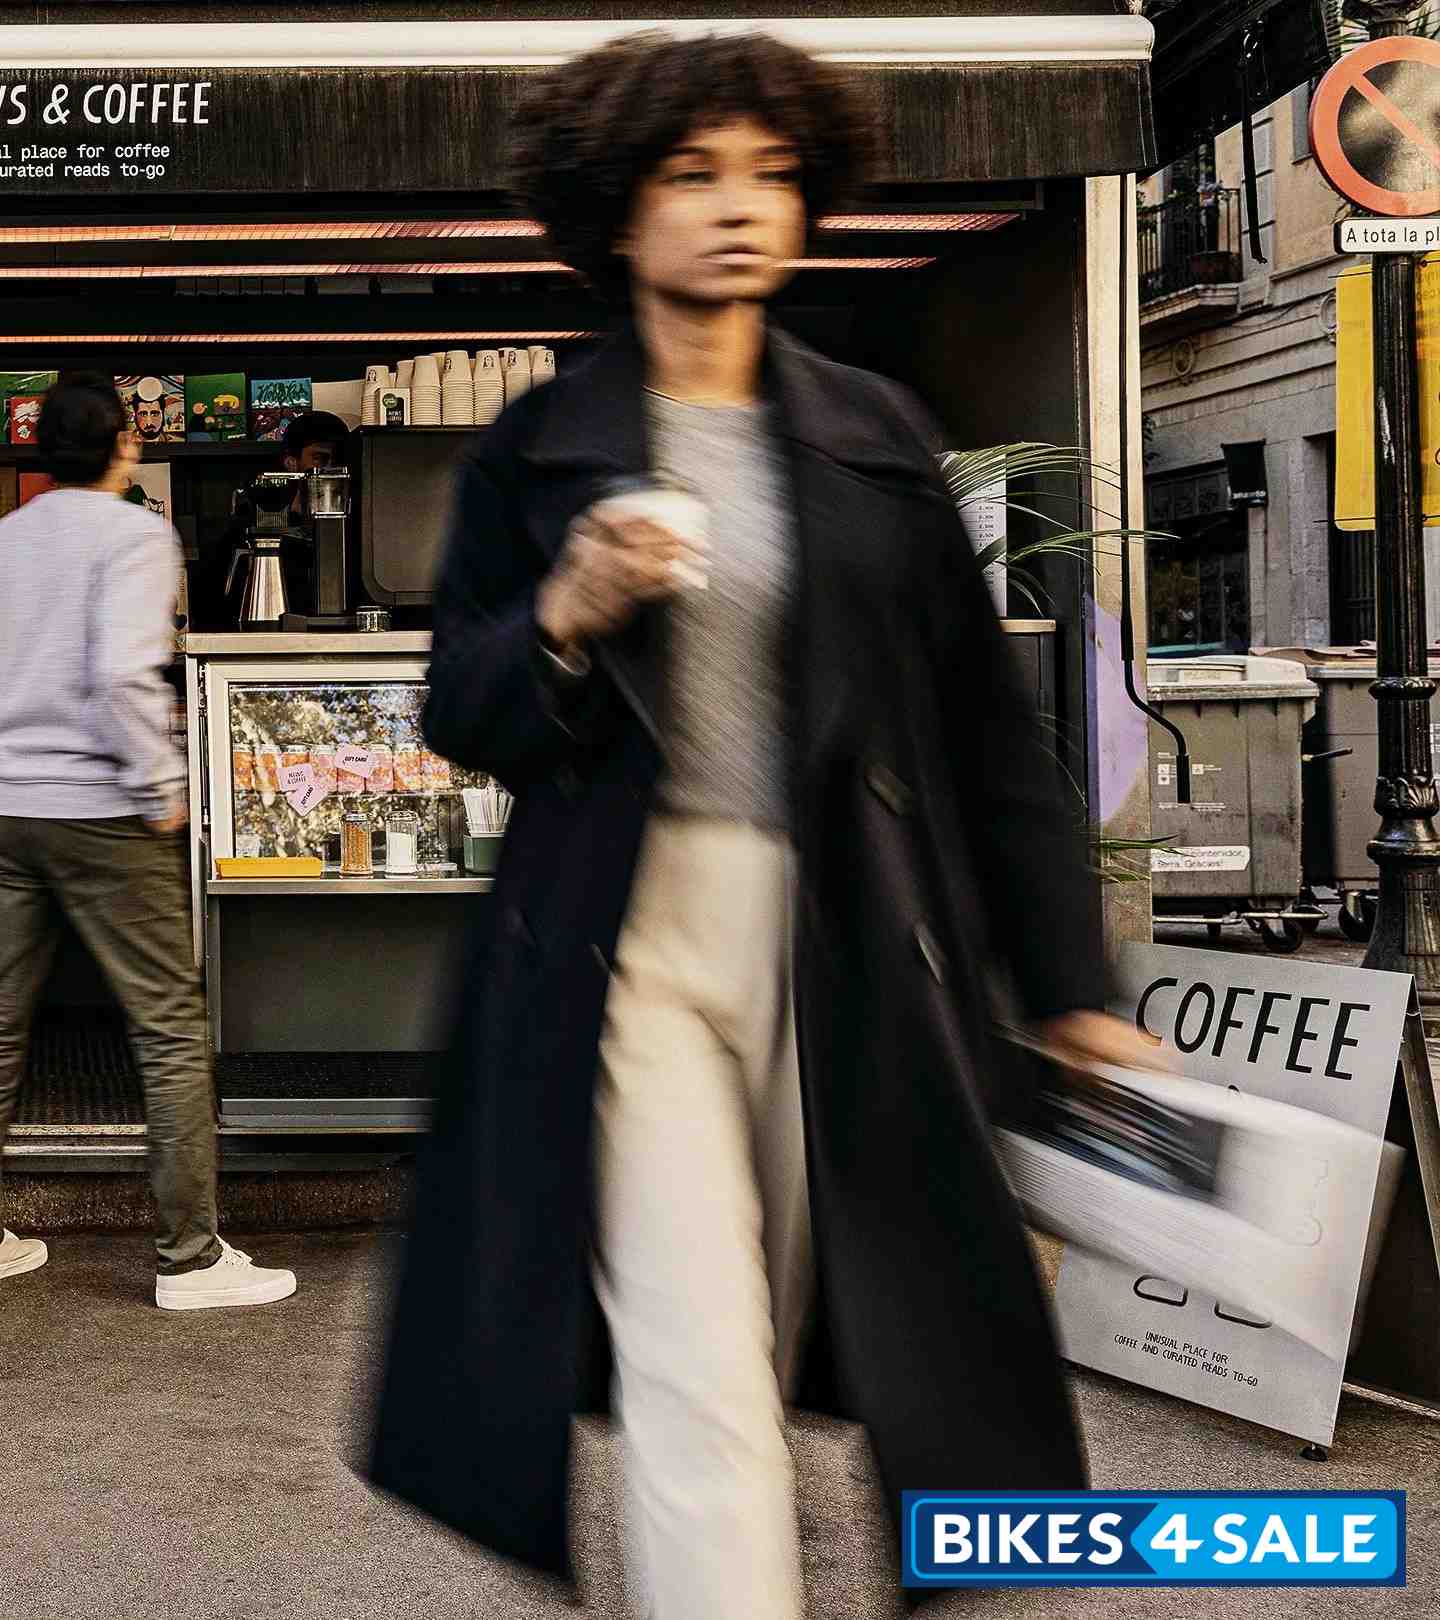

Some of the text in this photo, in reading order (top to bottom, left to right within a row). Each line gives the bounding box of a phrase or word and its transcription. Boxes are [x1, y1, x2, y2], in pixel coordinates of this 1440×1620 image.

[42, 83, 70, 125] &
[82, 82, 212, 125] COFFEE
[21, 145, 67, 164] place
[76, 144, 105, 159] for
[114, 144, 170, 159] coffee
[64, 163, 110, 178] reads
[120, 163, 165, 180] to-go
[1346, 227, 1357, 243] A
[1363, 228, 1396, 243] tota
[1404, 227, 1418, 243] la
[1135, 976, 1371, 1081] COFFEE
[1114, 1334, 1258, 1387] COFFEE AND CURATED READS TO-GO
[1145, 1331, 1229, 1365] UNUSUAL PLACE FOR
